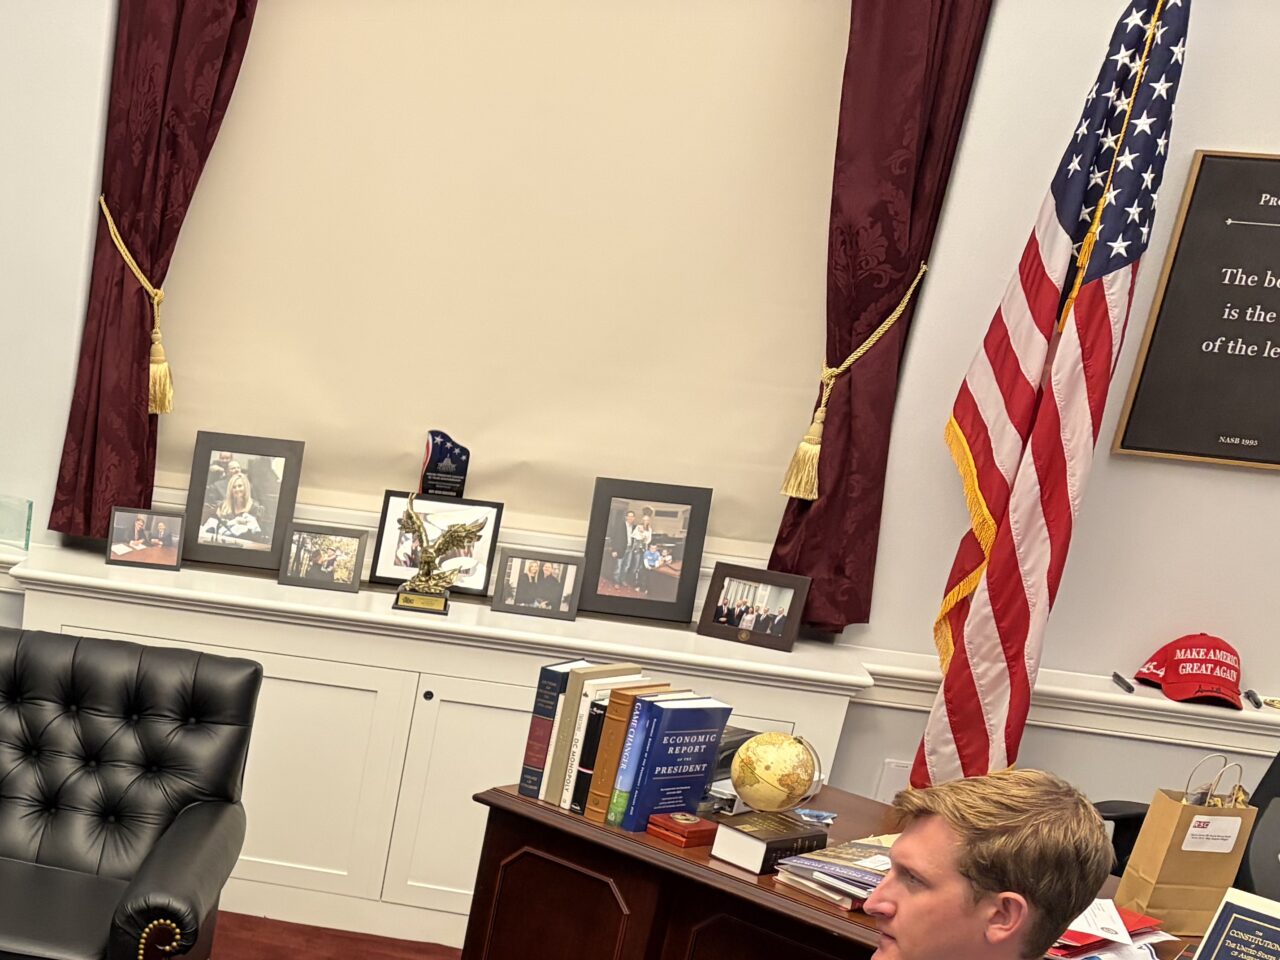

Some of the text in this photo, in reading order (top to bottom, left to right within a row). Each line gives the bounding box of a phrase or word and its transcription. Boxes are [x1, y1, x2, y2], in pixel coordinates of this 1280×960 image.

[1222, 268, 1258, 287] The
[1222, 303, 1277, 323] is the
[1202, 337, 1226, 353] of
[1226, 338, 1258, 356] the
[1218, 436, 1240, 445] NASB
[1174, 648, 1207, 660] MAKE
[1179, 663, 1238, 682] GREAT AGAIN
[620, 702, 642, 769] GAME CHANGER
[662, 734, 717, 744] ECONOMIC
[668, 745, 707, 754] REPORT
[565, 738, 580, 793] DC MONOPOLY
[655, 764, 708, 775] PRESIDENT
[1230, 930, 1280, 952] CONSTITUTION
